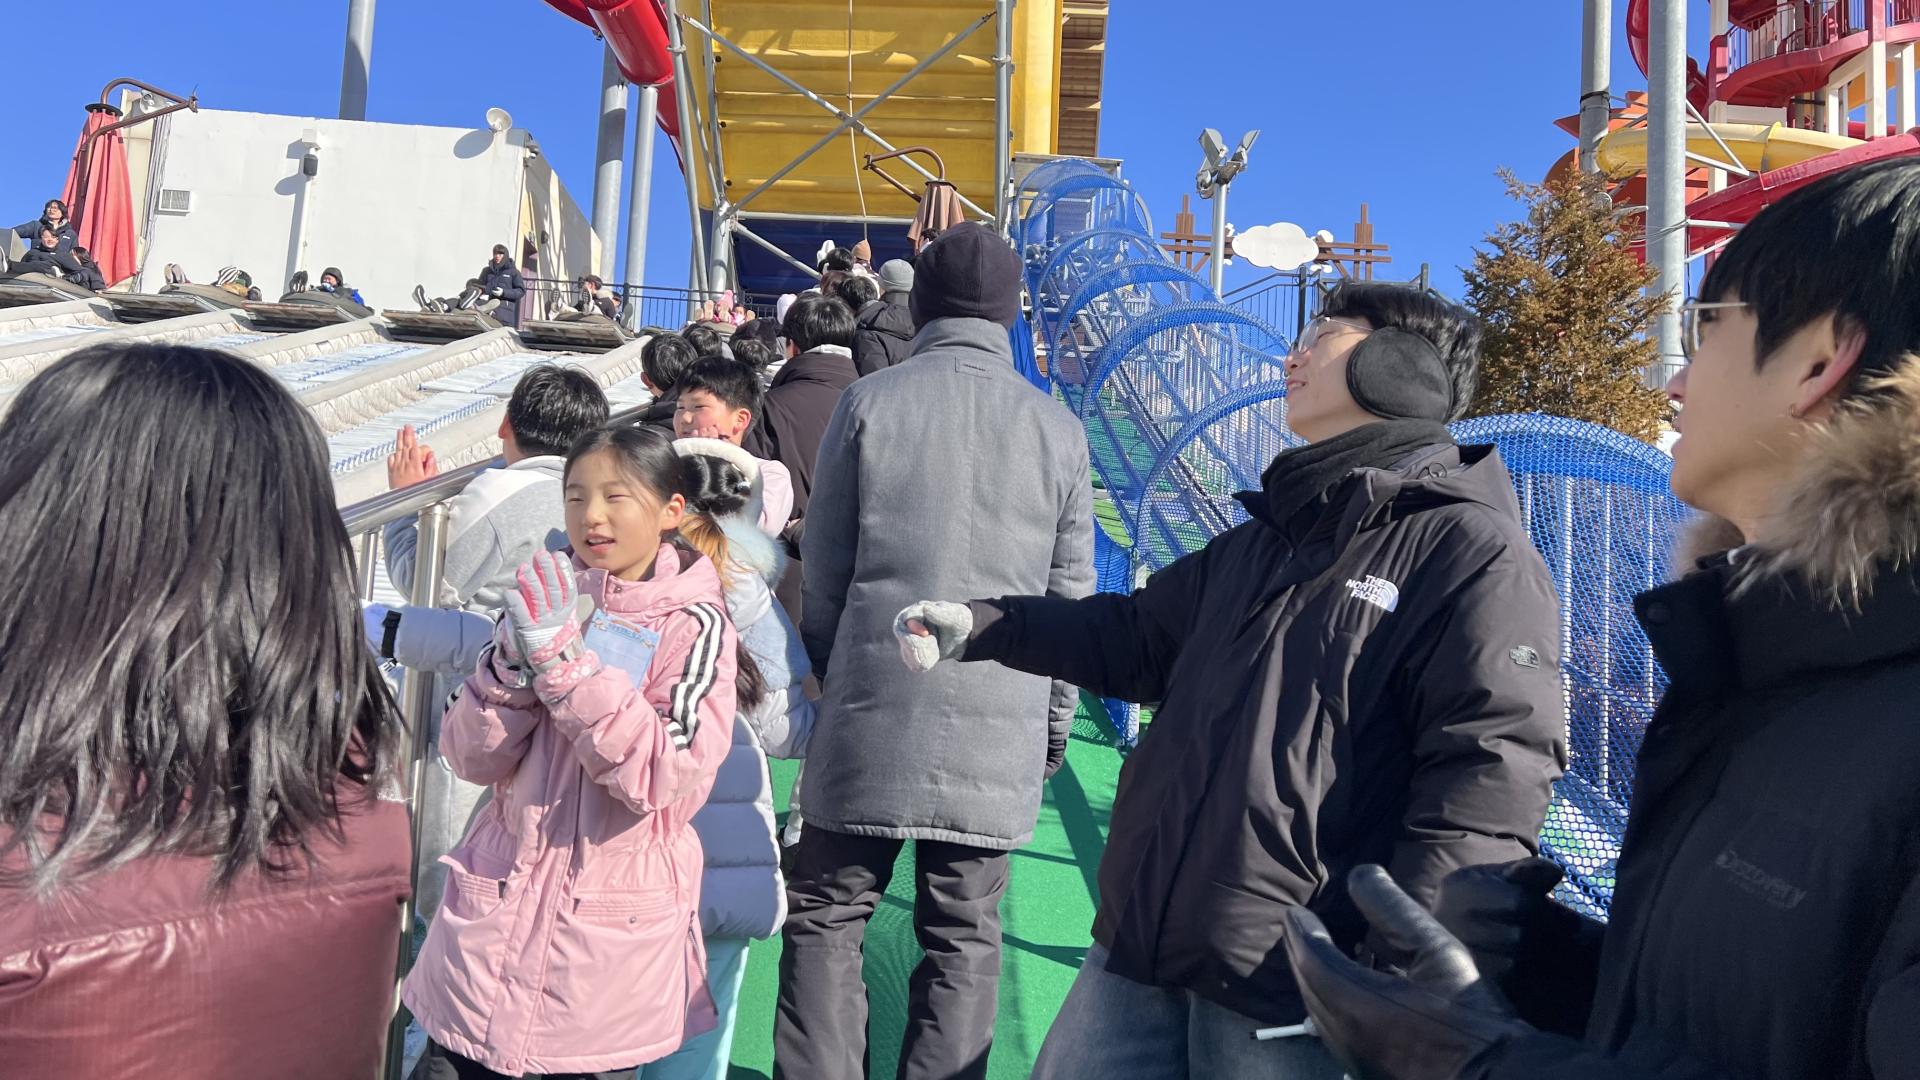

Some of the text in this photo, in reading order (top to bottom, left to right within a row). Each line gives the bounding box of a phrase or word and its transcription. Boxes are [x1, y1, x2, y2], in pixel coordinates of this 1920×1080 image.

[1345, 578, 1383, 596] NORTH
[1366, 574, 1386, 587] THE
[1350, 588, 1378, 604] FACE
